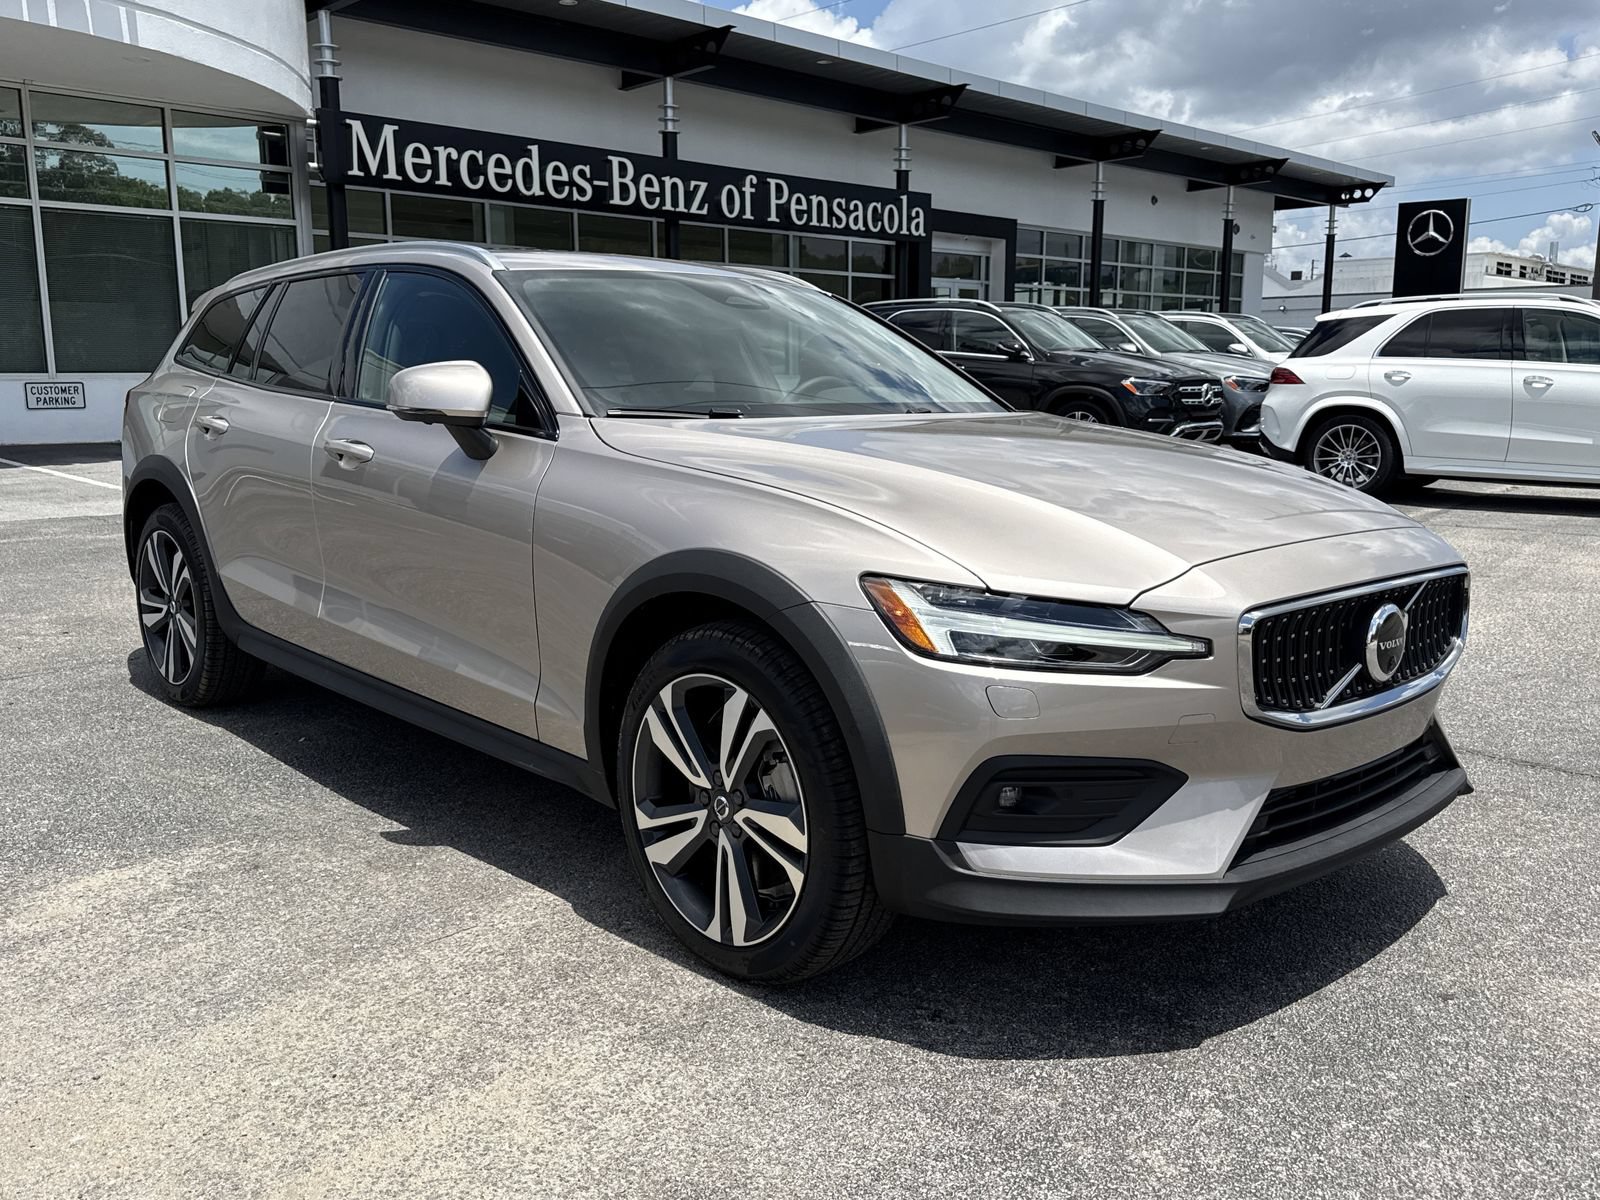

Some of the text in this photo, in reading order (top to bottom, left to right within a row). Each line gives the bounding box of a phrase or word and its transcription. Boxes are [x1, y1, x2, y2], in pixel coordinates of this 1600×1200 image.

[345, 118, 926, 237] Mercedes-Benz of Pensacola
[30, 386, 80, 396] CUSTOMER
[36, 396, 77, 406] PARKING
